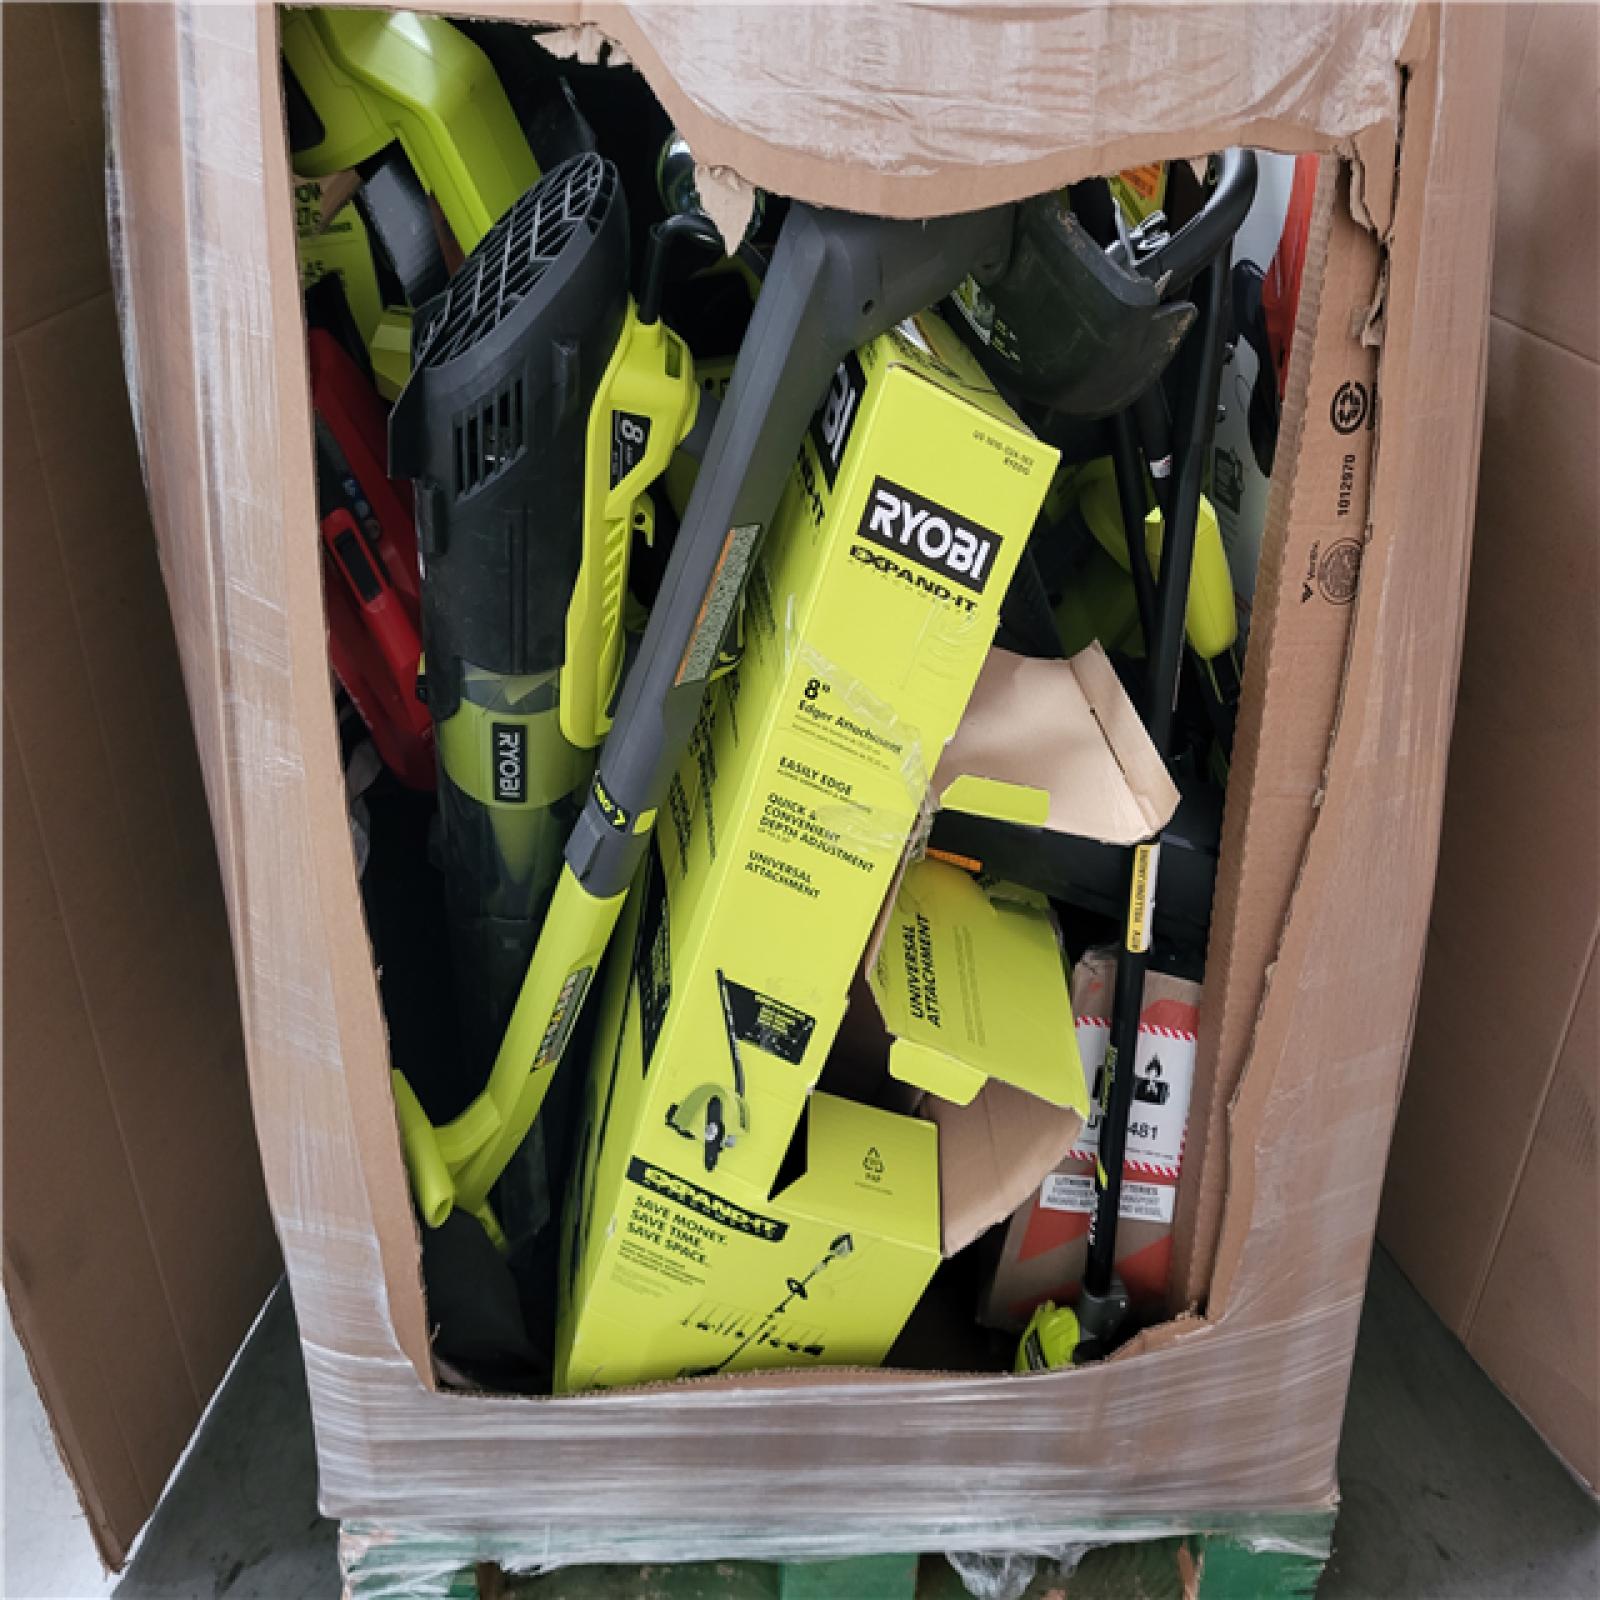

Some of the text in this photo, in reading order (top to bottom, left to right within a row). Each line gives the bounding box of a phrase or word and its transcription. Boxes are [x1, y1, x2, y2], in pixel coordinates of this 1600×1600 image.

[869, 488, 991, 581] RYOBI
[849, 544, 978, 613] EXPAND-IT
[799, 699, 832, 721] Edger
[499, 731, 521, 798] RYOBI
[779, 756, 820, 781] EASILY
[820, 774, 853, 796] EDGE
[764, 804, 841, 844] CONVENIENT
[767, 792, 806, 815] QUICK
[749, 850, 811, 883] UNIVERSAL
[760, 815, 799, 837] DEPTH
[800, 832, 875, 873] ADJUSTMENT
[745, 862, 820, 898] ATTACHMENT
[902, 924, 925, 1018] UNIVERSAL
[915, 911, 941, 1029] ATTACHMENT
[631, 1209, 705, 1250] SAVE TIME.
[635, 1195, 728, 1246] SAVE MONEY.
[627, 1222, 661, 1245] SAVE
[665, 1239, 712, 1268] SPACE.
